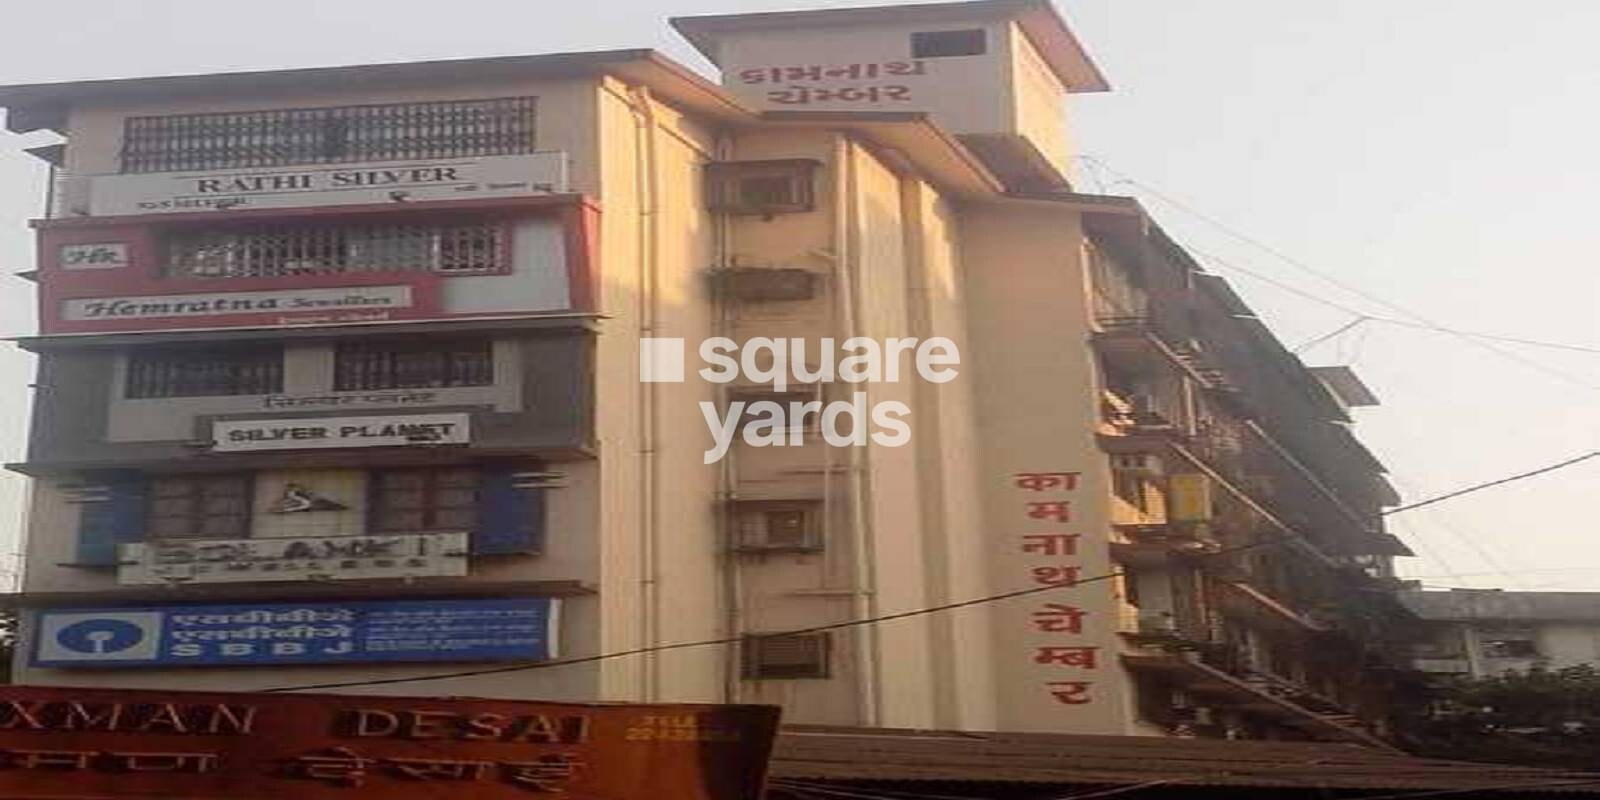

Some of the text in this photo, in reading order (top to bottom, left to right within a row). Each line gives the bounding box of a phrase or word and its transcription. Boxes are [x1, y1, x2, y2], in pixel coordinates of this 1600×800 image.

[196, 167, 459, 193] RATHI SILVER
[83, 296, 278, 318] Hemratna
[228, 426, 328, 443] SILVER
[355, 707, 592, 743] DESAI
